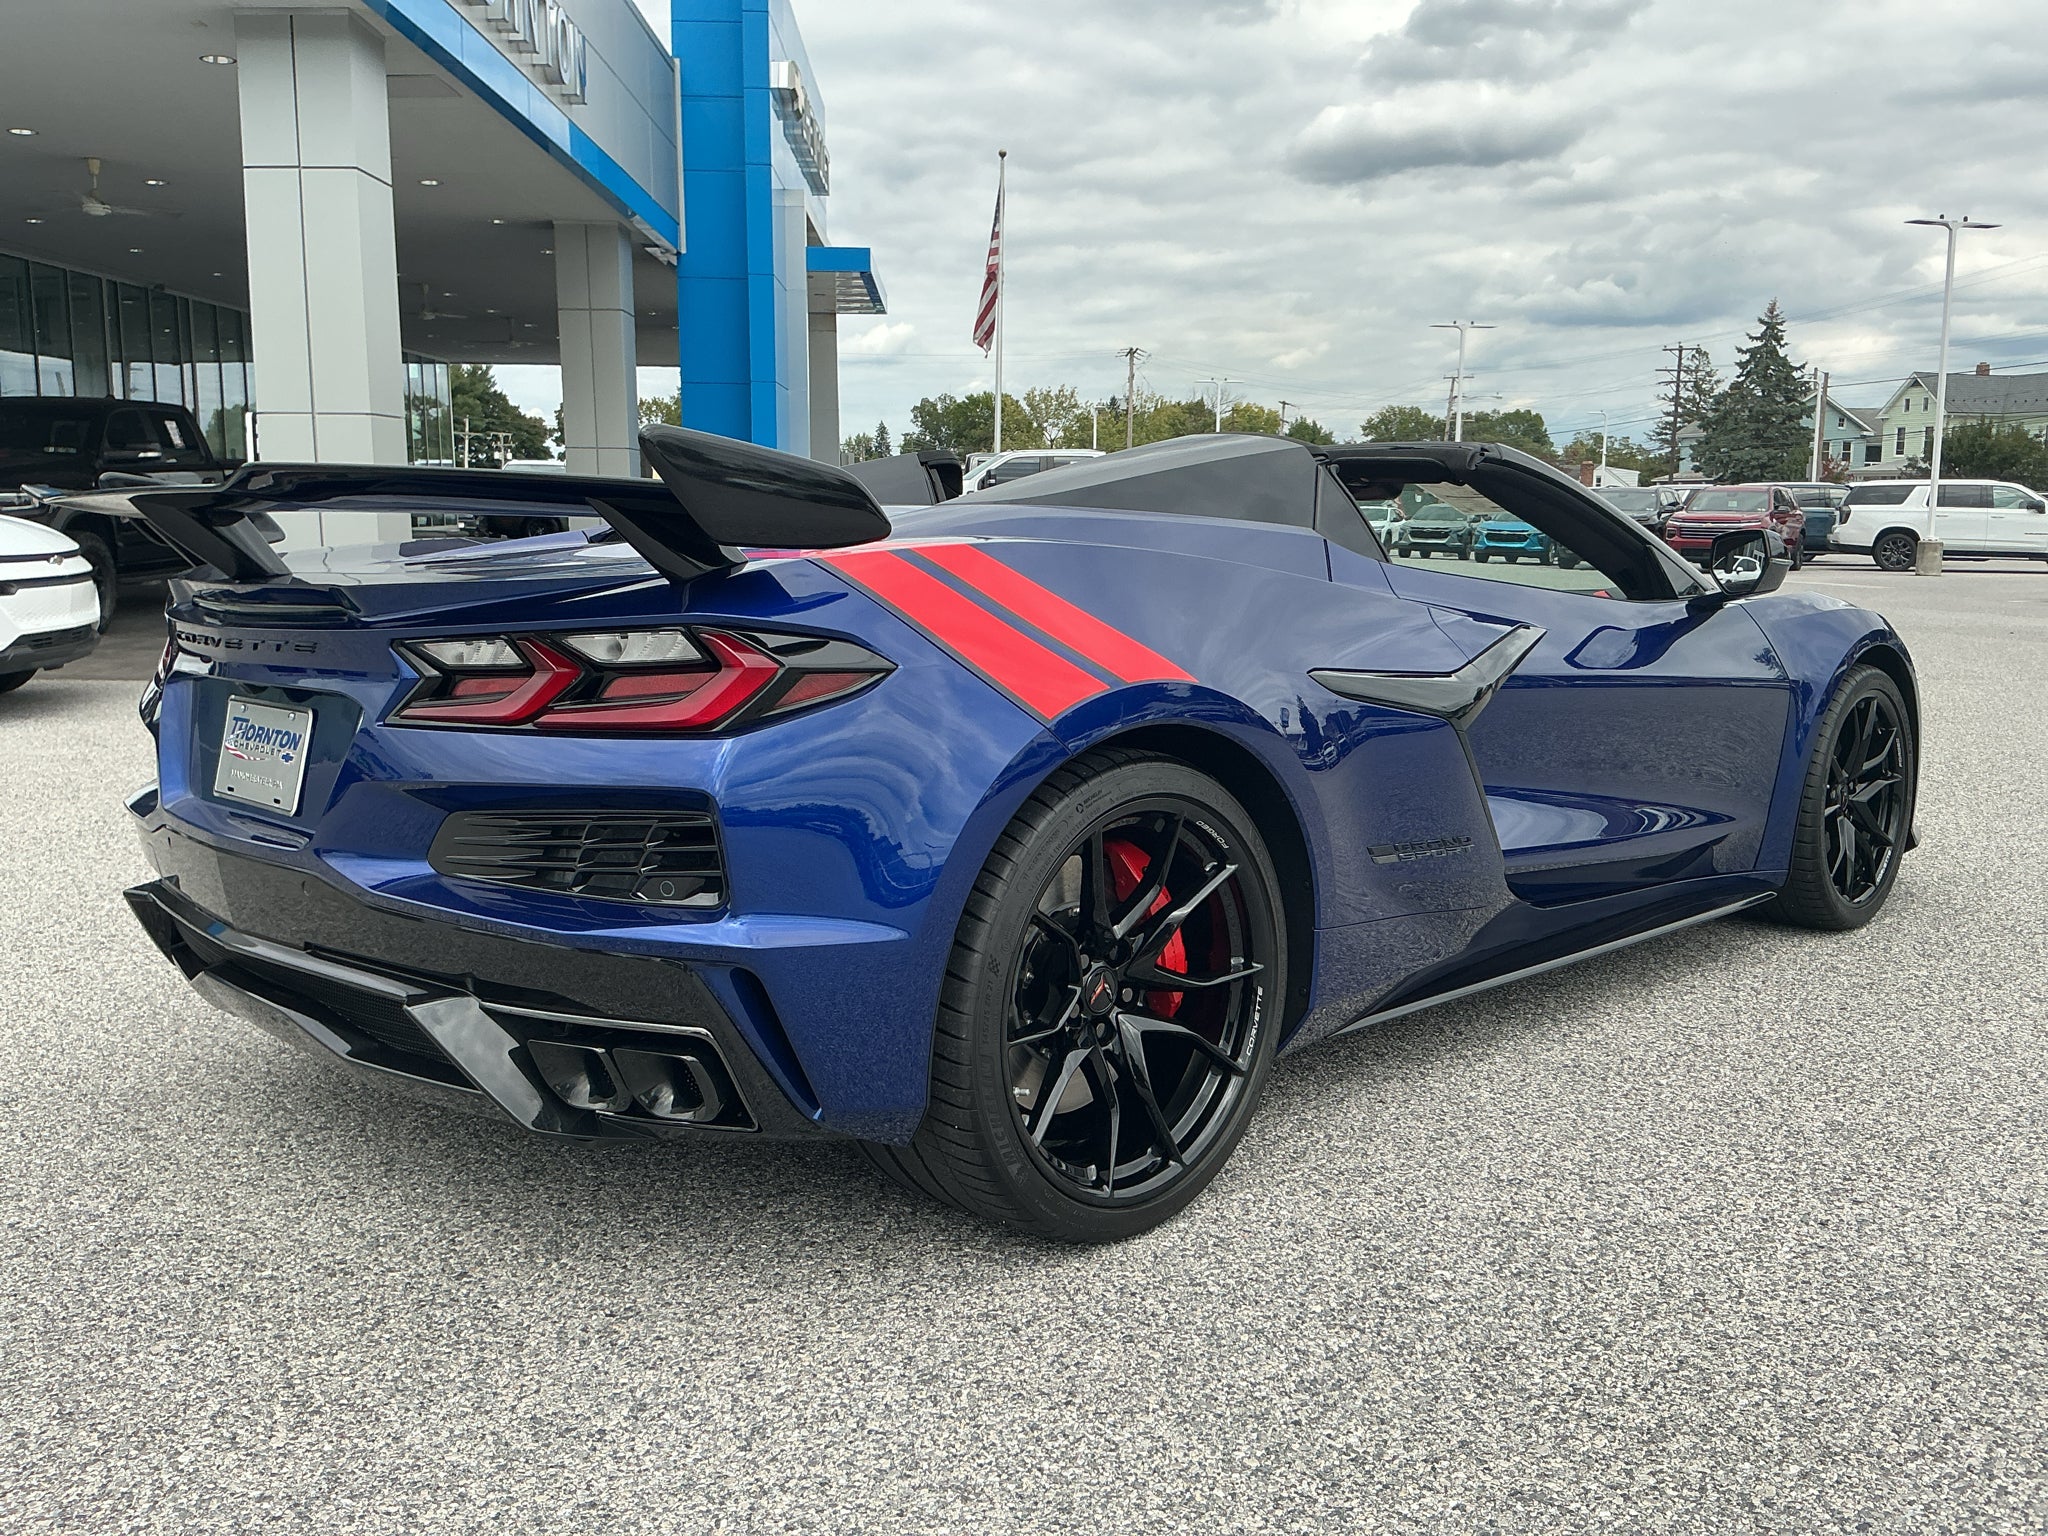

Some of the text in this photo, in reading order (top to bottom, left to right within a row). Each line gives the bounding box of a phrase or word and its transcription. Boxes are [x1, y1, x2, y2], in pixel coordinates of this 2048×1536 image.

[176, 630, 318, 654] CORVETTE
[230, 716, 302, 750] THORNTON
[233, 740, 282, 757] CHEVROLET
[1195, 820, 1230, 849] FORGED
[1395, 836, 1472, 851] GRAND
[1399, 845, 1475, 861] SPORT
[1246, 985, 1264, 1056] CORVETTE
